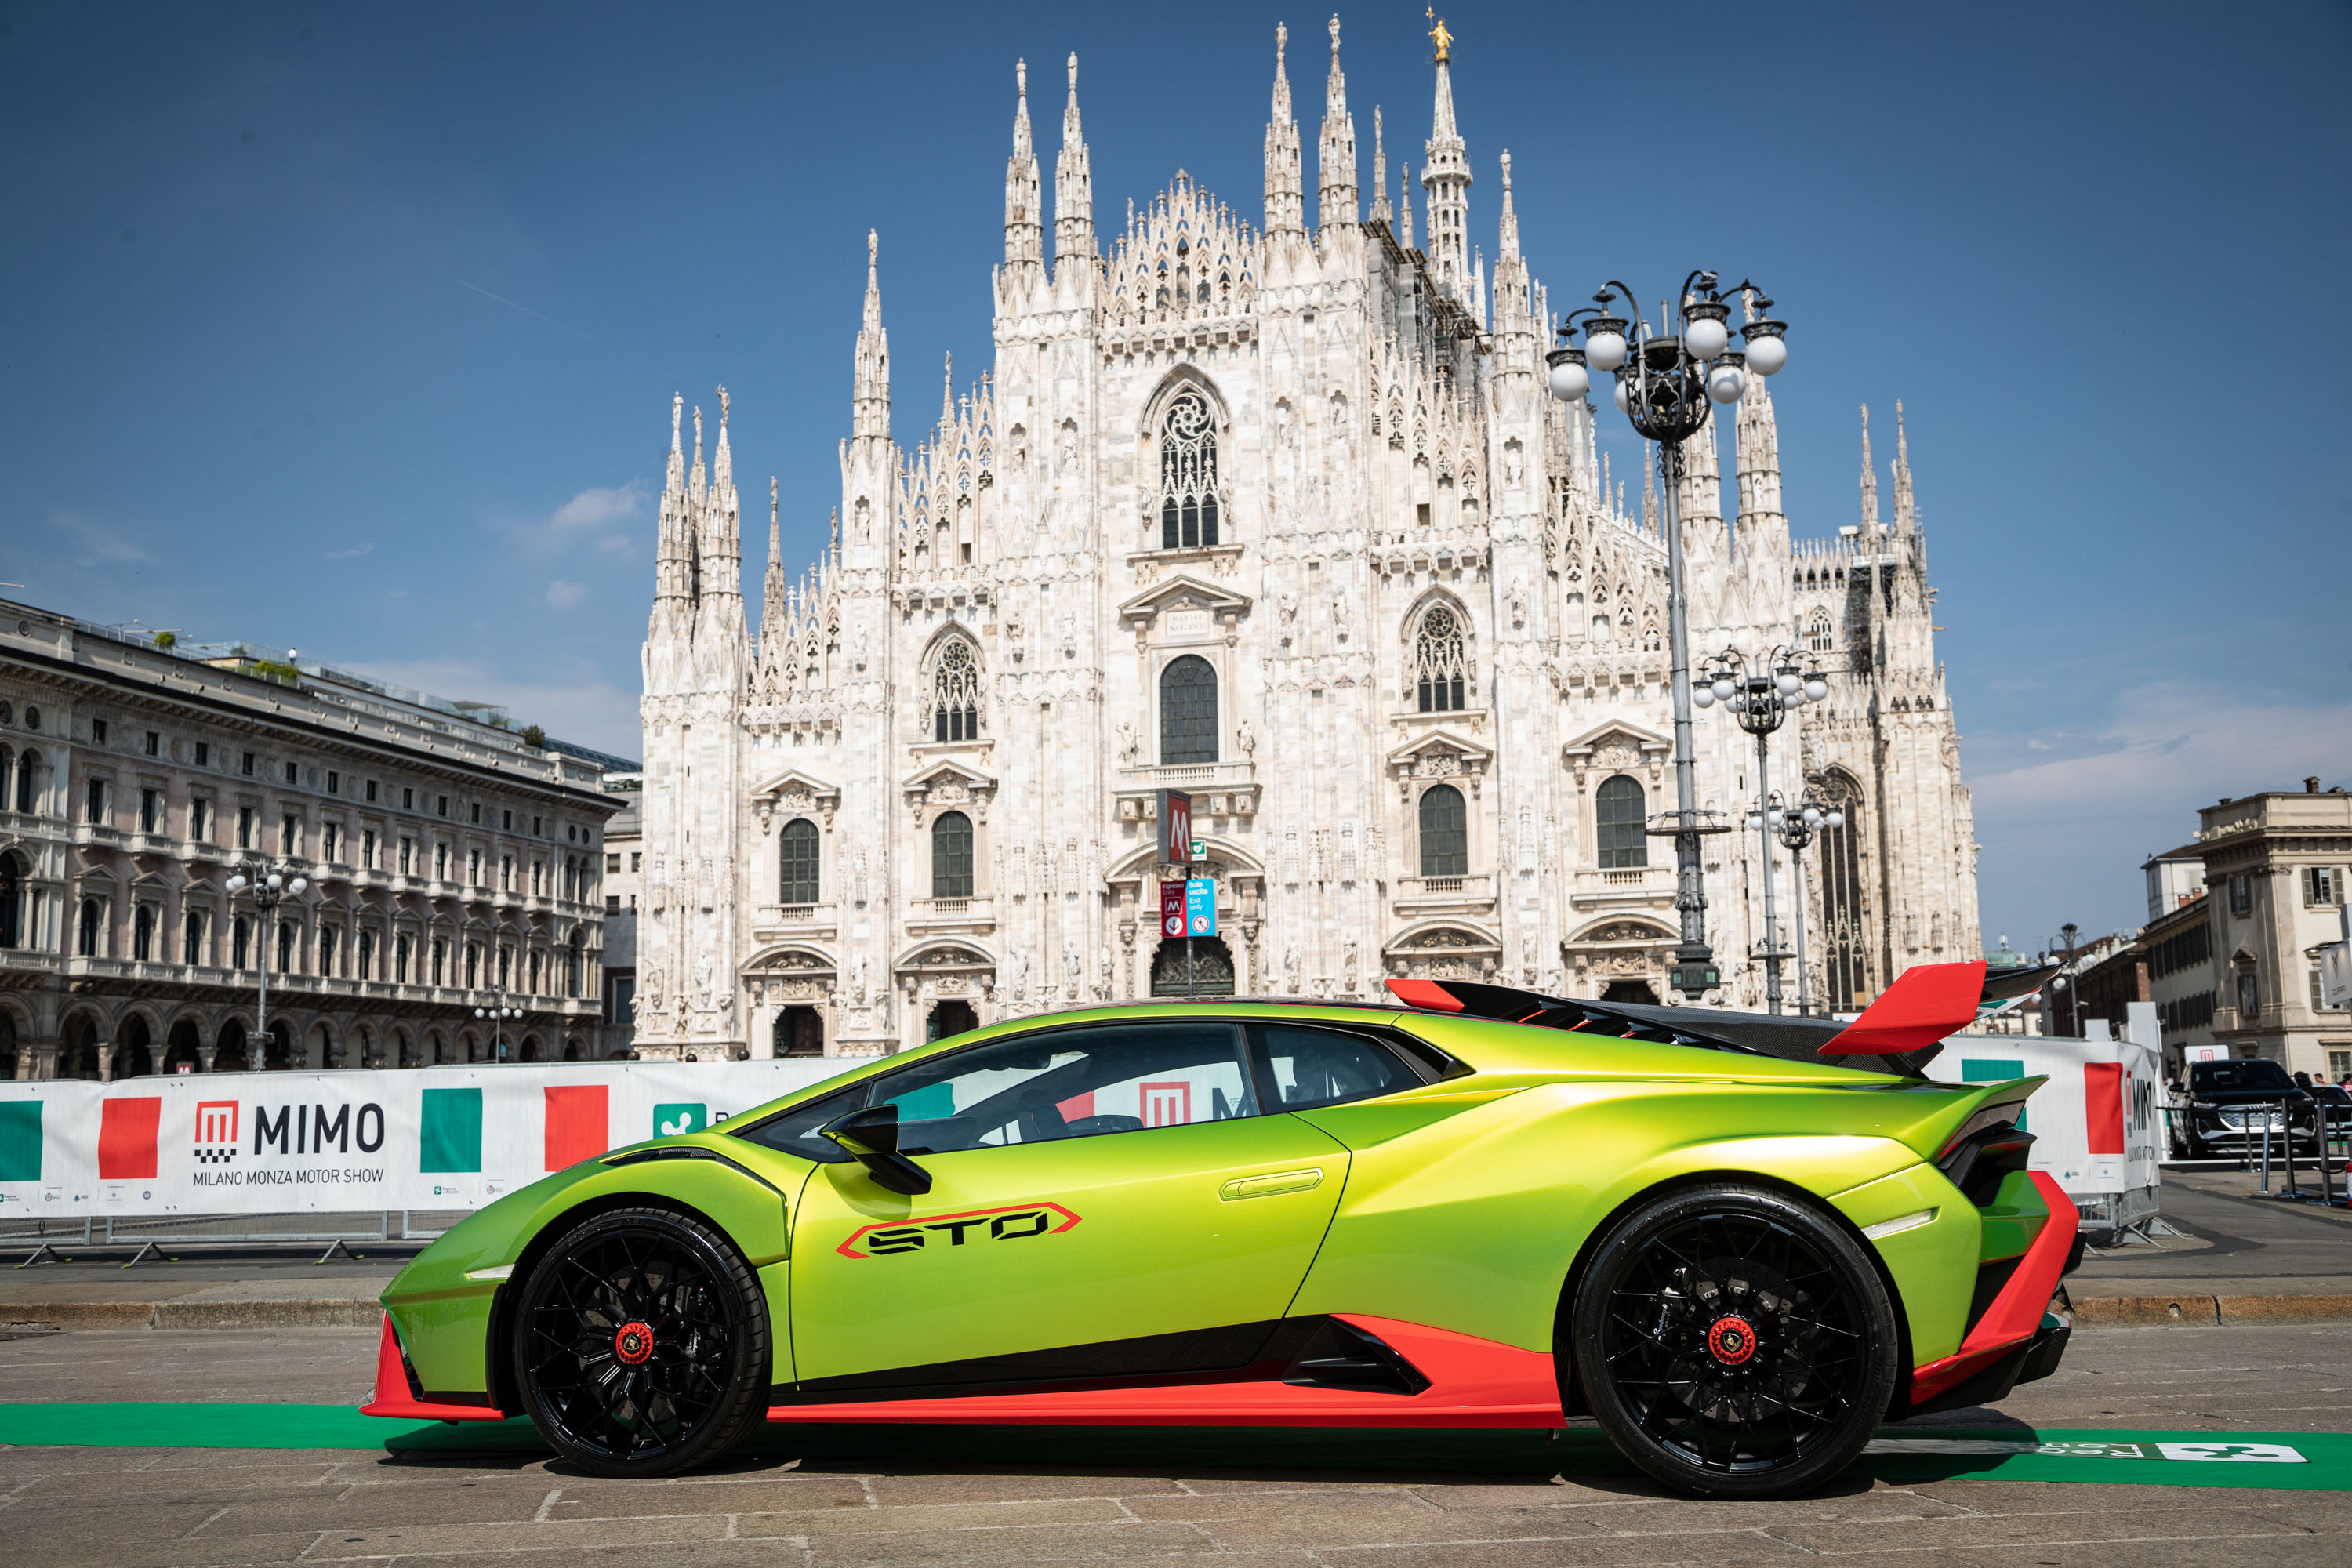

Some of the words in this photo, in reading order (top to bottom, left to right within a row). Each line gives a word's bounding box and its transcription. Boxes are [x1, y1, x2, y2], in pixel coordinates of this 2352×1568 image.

[1171, 809, 1190, 852] M
[1167, 900, 1180, 912] M
[254, 1102, 385, 1156] MIMO
[194, 1171, 243, 1186] MILANO
[246, 1170, 292, 1185] MONZA
[296, 1169, 339, 1185] MOTOR
[343, 1168, 384, 1184] SHOW
[868, 1211, 1048, 1255] STO
